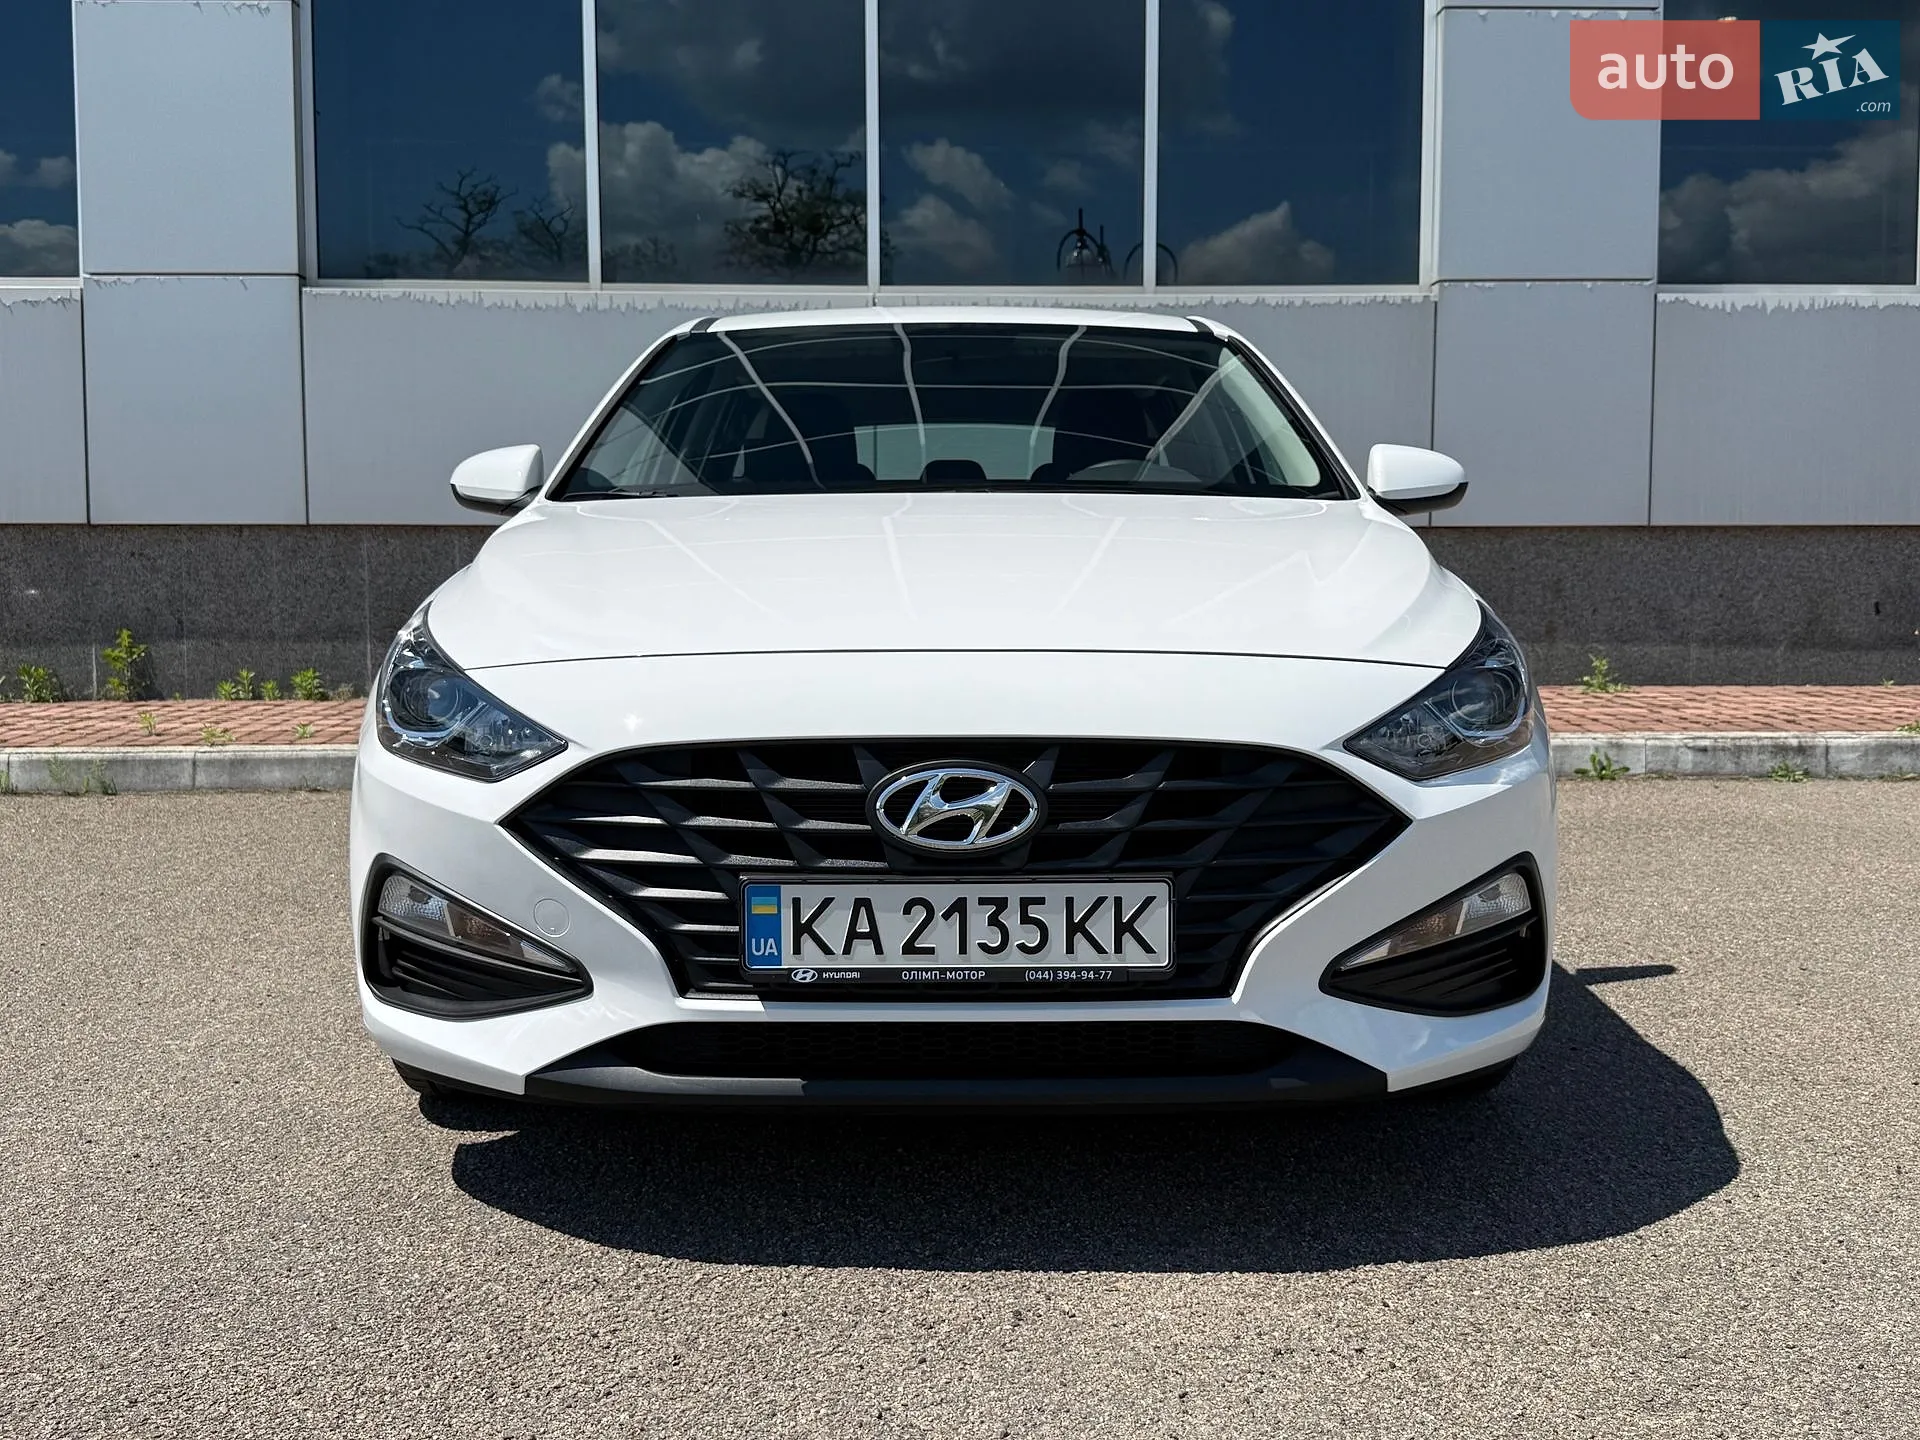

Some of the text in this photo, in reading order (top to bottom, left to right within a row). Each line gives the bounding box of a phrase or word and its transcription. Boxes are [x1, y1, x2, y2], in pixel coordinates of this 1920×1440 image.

[791, 895, 1158, 956] KA 2135 KK
[751, 937, 778, 956] UA
[822, 971, 861, 980] HYUNDAI
[901, 970, 986, 981] ОЛІМП-МОТОР
[1024, 969, 1113, 982] (044) 394-94-77
